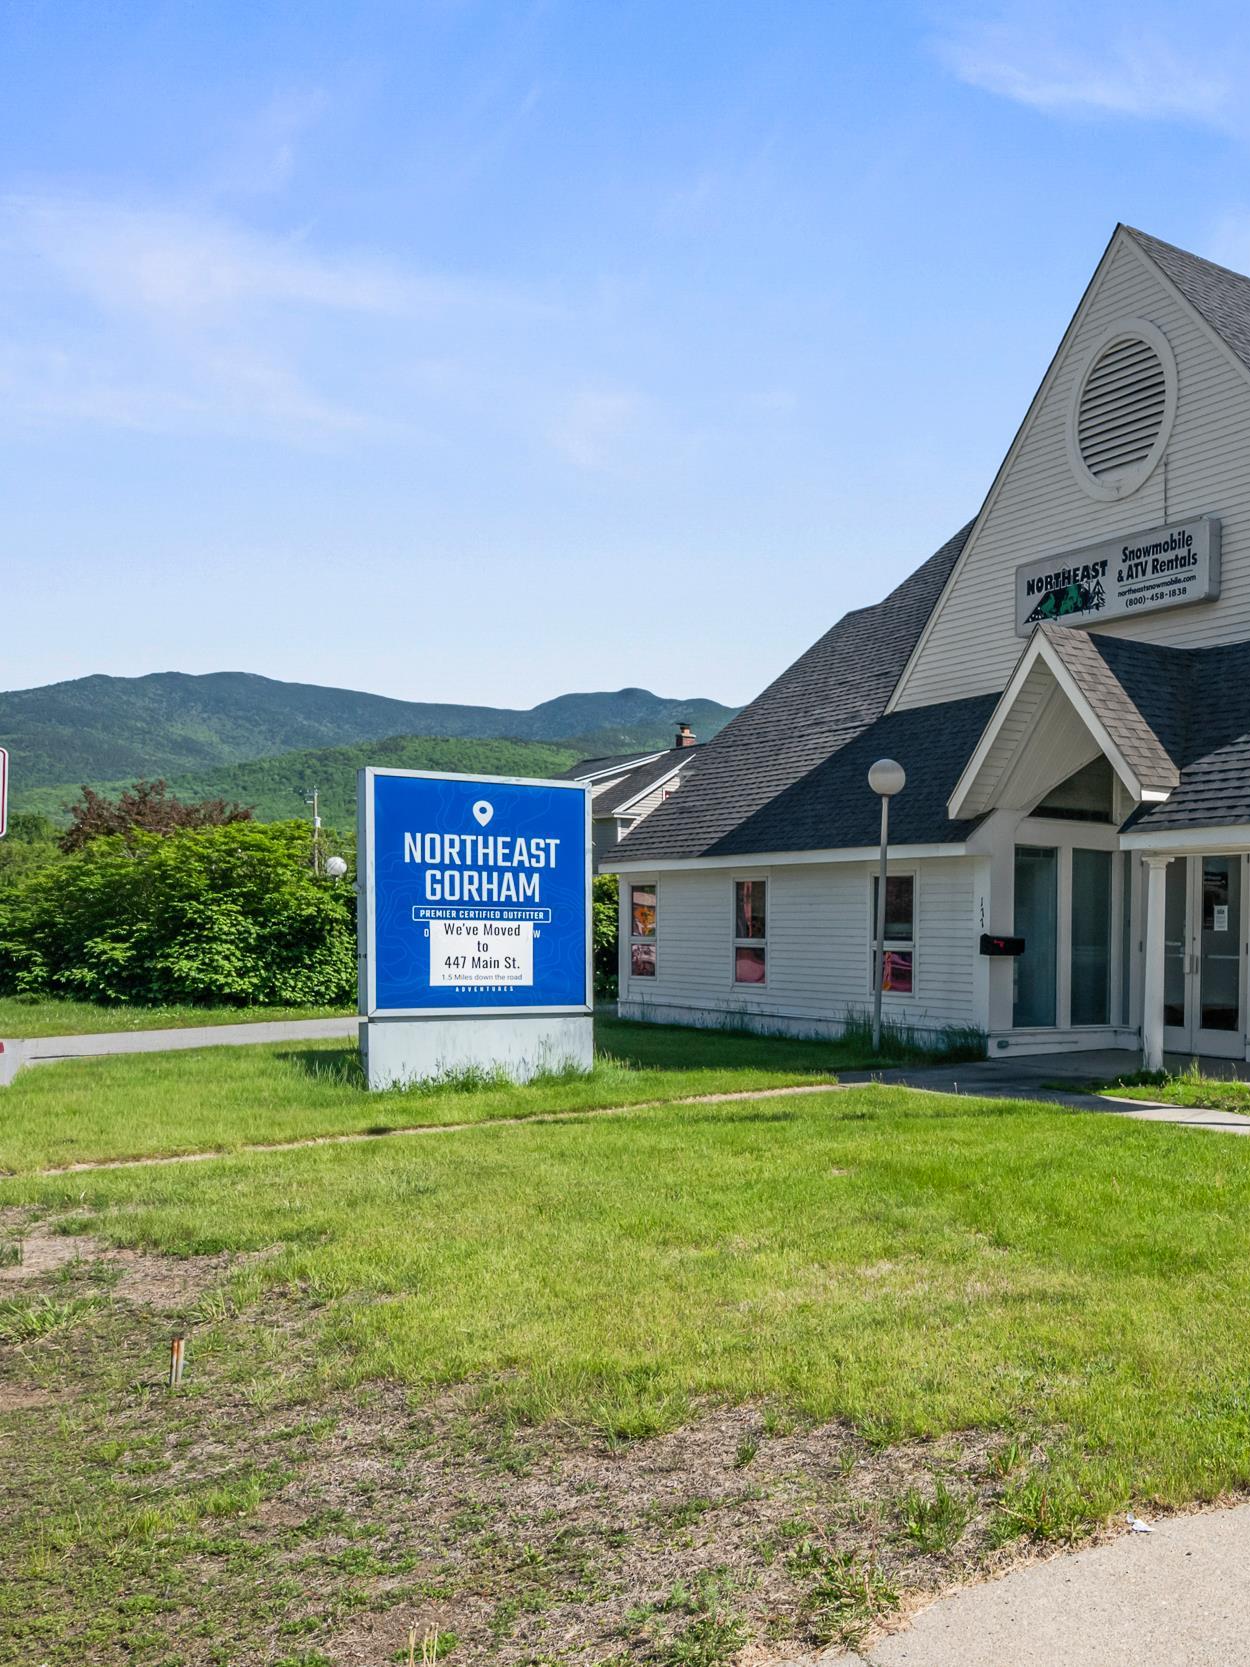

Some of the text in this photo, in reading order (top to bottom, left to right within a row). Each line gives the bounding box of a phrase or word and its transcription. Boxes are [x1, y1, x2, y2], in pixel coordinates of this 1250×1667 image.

[1121, 530, 1193, 563] Snowmobile
[1026, 559, 1108, 596] NORTHEAST
[1117, 548, 1198, 583] & ATV Rentals
[1117, 575, 1197, 597] northeastsnowmobile.com
[404, 832, 560, 869] NORTHEAST
[425, 870, 540, 903] GORHAM
[420, 909, 544, 920] PREMIER CERTIFIED OUTFITTER
[443, 922, 479, 936] We've
[483, 923, 521, 936] Moved
[477, 940, 489, 953] to
[444, 956, 520, 969] 447 Main St.
